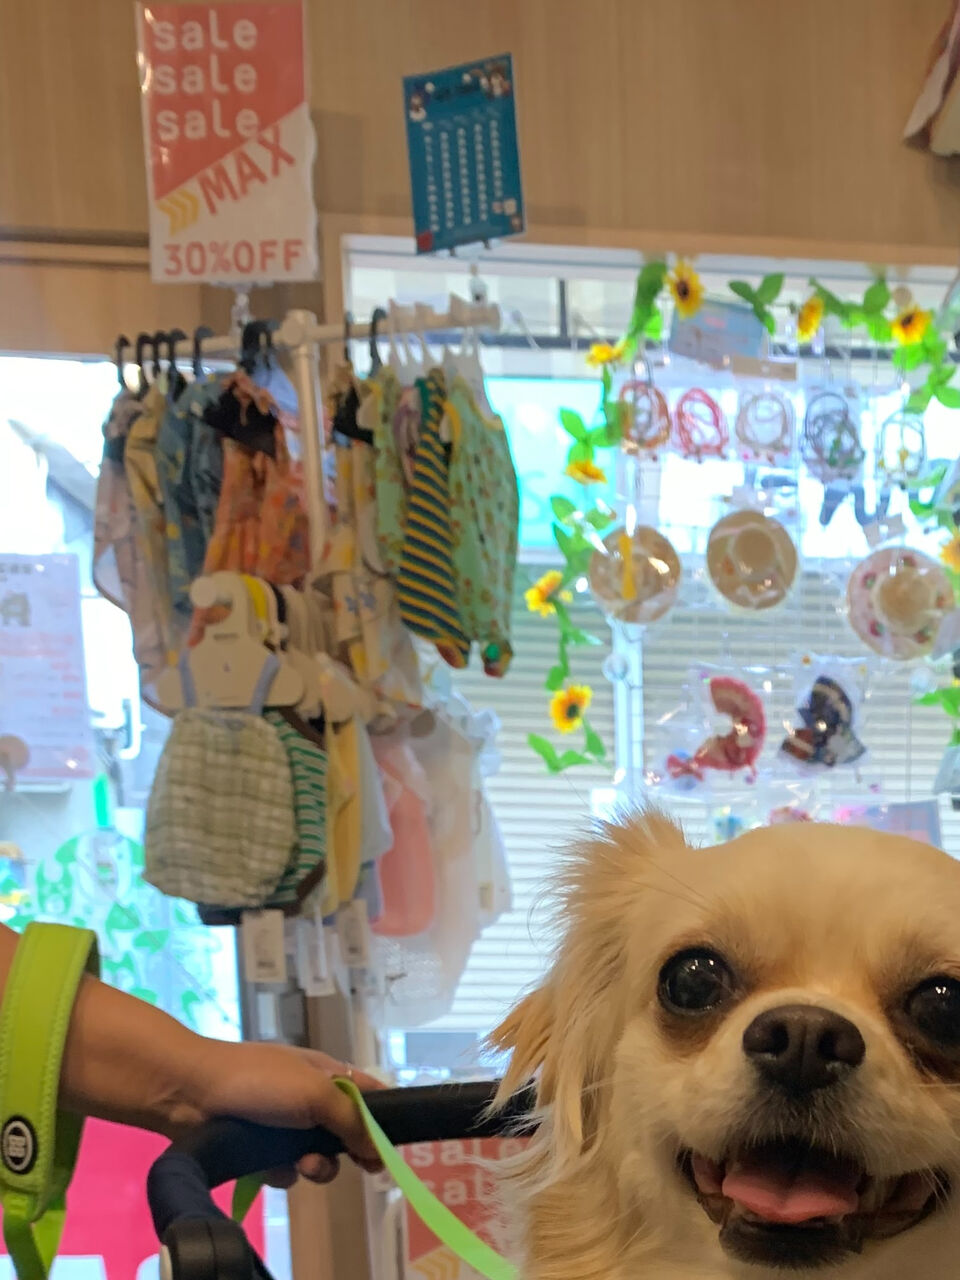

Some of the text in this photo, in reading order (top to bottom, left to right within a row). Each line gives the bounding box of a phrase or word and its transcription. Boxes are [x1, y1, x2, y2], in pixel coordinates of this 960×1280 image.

[153, 10, 258, 50] sale
[153, 54, 258, 95] sale
[156, 100, 259, 141] sale
[197, 124, 296, 216] MAX
[162, 239, 304, 277] 30%OFF
